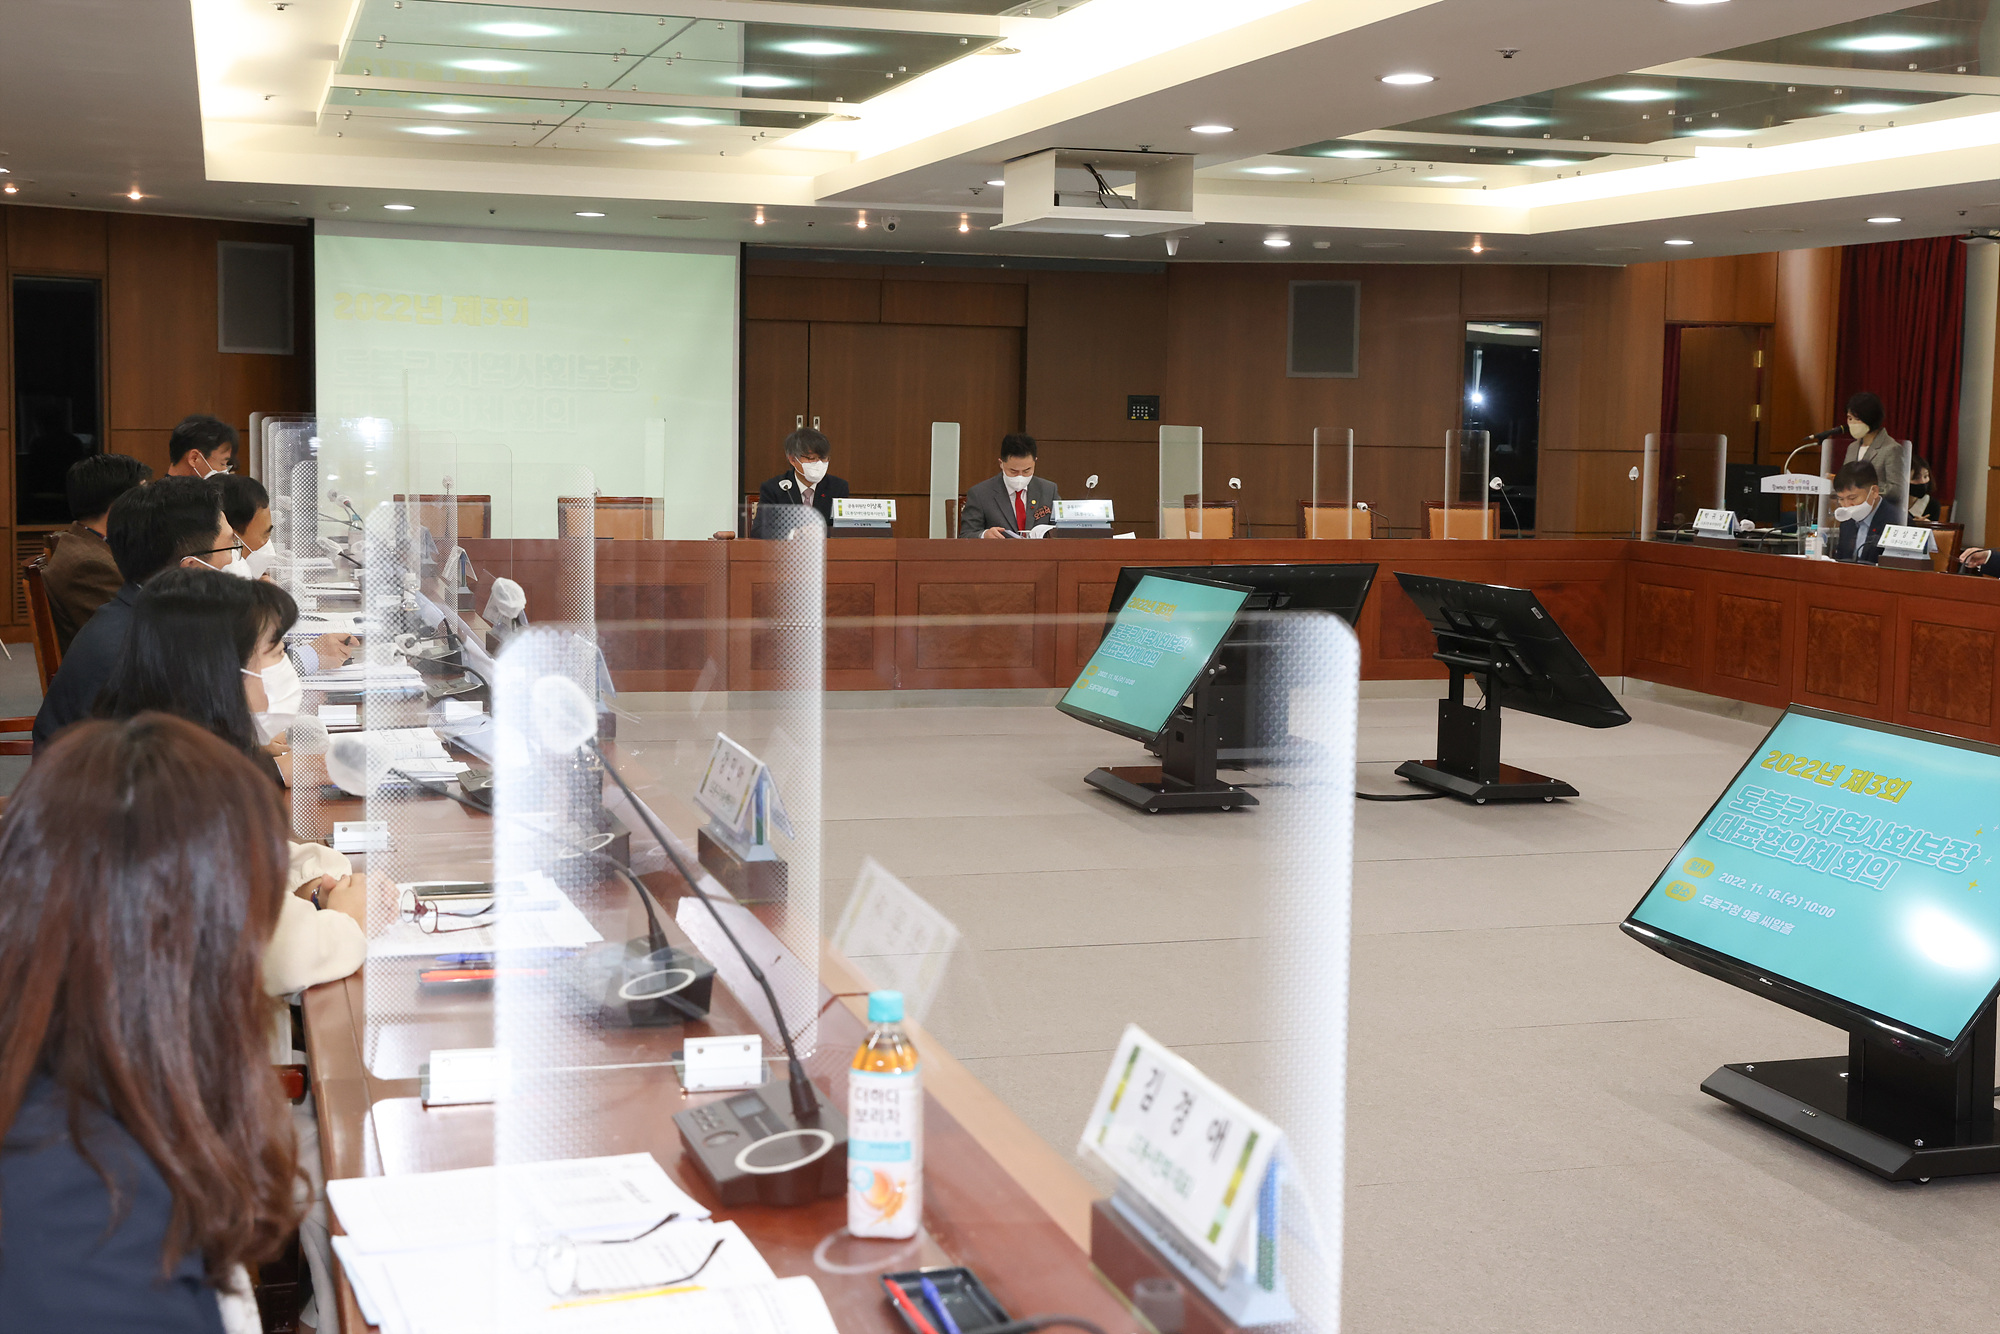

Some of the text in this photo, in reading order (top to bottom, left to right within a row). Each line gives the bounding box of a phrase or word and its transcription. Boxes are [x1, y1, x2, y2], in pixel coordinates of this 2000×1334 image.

[333, 292, 529, 328] 2022년 제3회
[1760, 750, 1912, 804] 2022년 제3회
[1707, 812, 1901, 891] 대표협의체 회의
[1728, 784, 1981, 873] 도봉구 지역사회보장
[1699, 894, 1743, 917] 도봉구청
[1741, 909, 1761, 923] 9층
[1718, 872, 1746, 890] 2022.
[1749, 882, 1763, 895] 11.
[1803, 900, 1836, 918] 10:00
